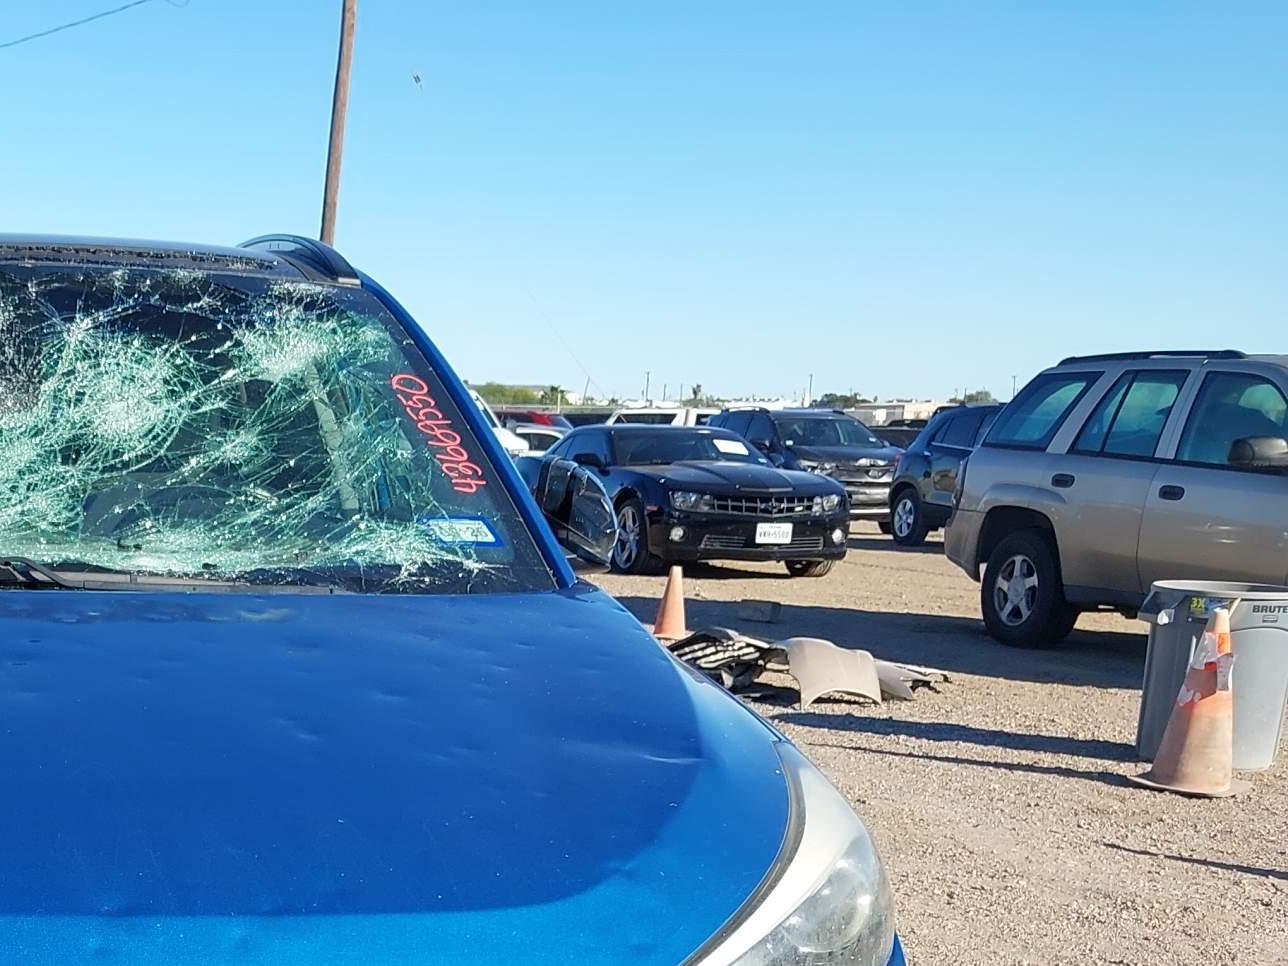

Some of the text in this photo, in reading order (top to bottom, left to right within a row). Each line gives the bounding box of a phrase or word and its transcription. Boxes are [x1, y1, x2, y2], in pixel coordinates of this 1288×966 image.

[391, 373, 488, 495] 43669550
[1191, 597, 1206, 609] 3X
[1252, 605, 1288, 614] BRUTE
